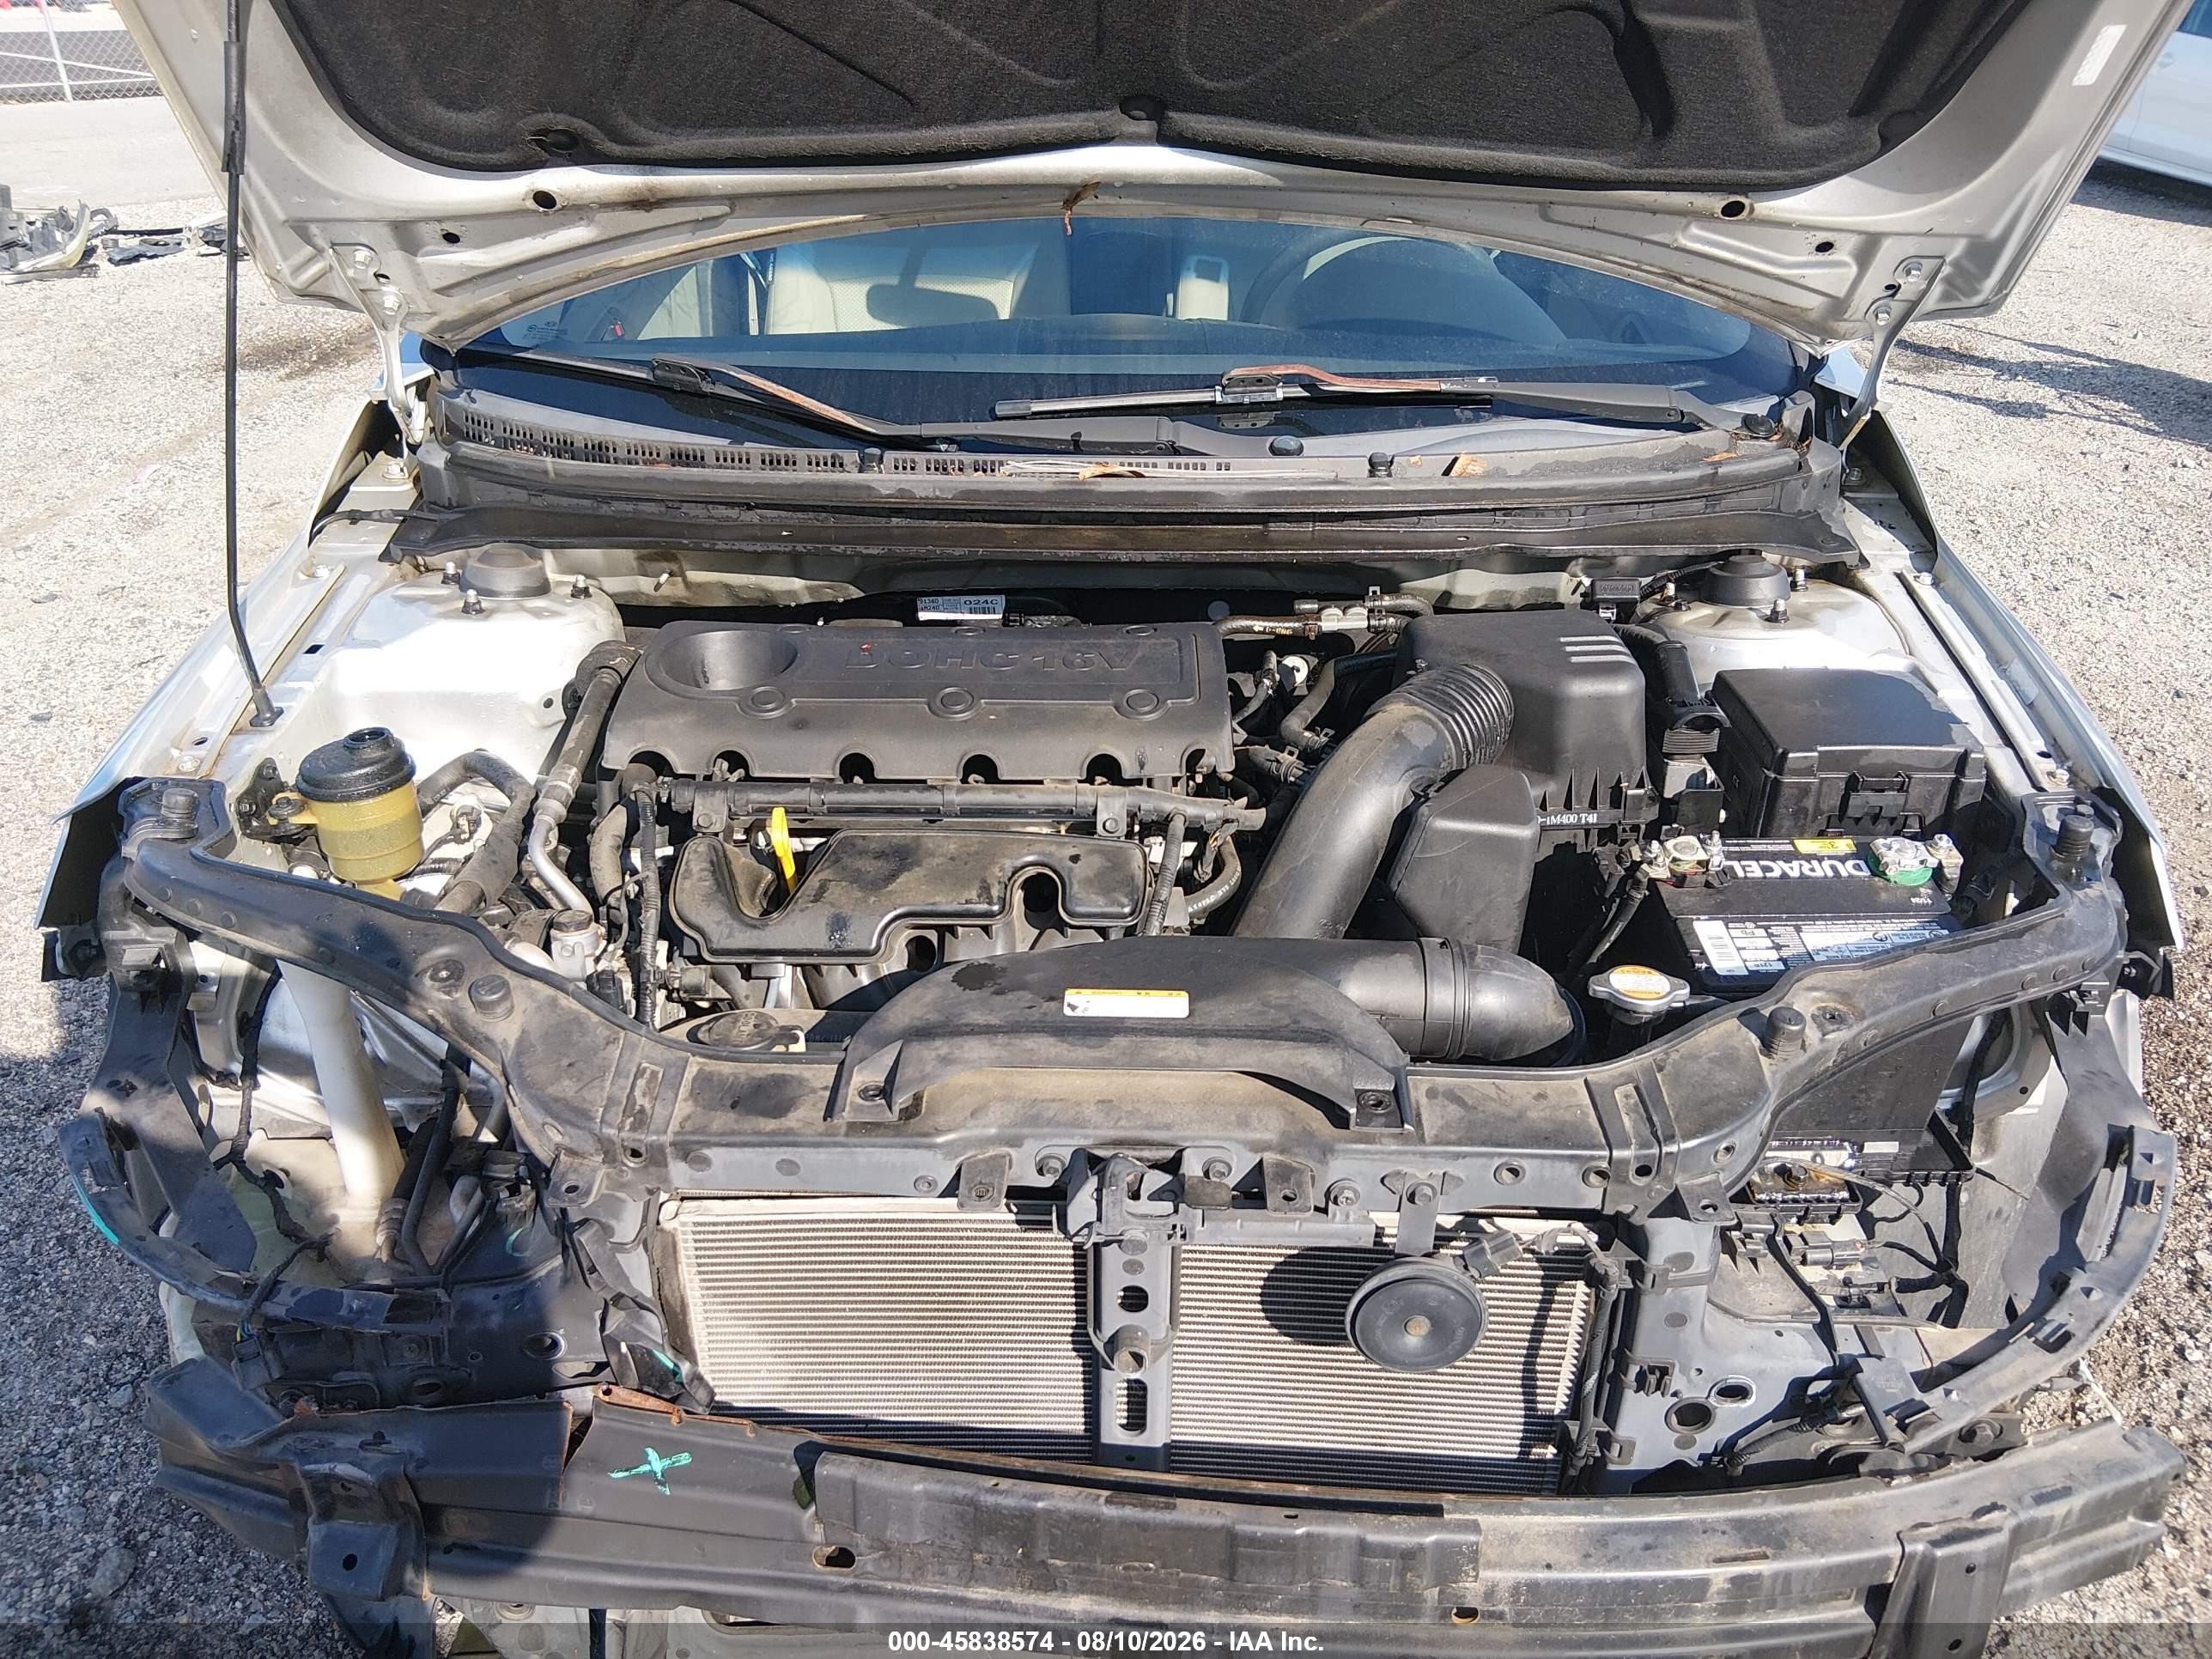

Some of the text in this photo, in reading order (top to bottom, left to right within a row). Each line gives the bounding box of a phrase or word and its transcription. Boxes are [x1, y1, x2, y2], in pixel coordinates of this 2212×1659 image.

[845, 650, 1140, 672] DOHC 16V
[1723, 860, 1871, 878] DURACEL
